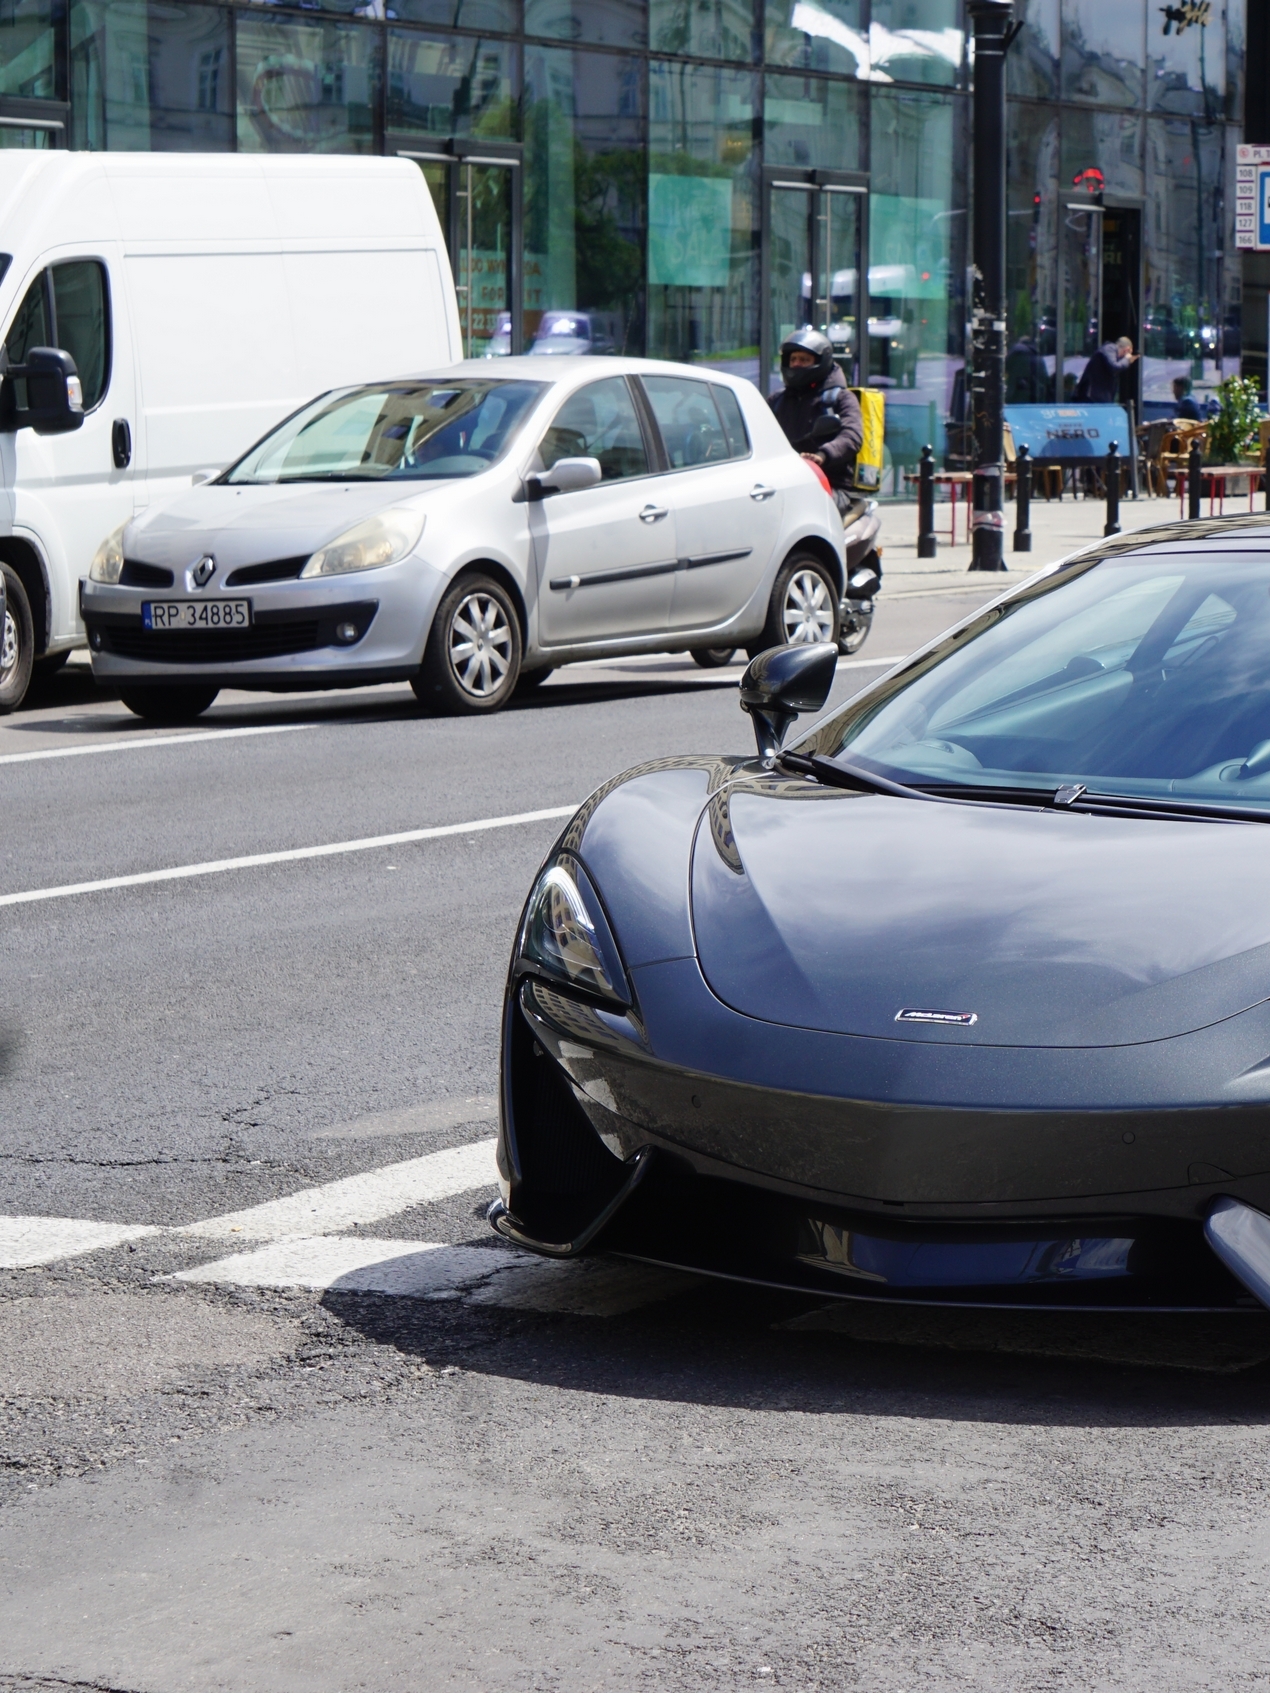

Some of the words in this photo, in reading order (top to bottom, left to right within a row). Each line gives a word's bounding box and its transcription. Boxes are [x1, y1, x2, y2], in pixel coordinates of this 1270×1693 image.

[1253, 150, 1264, 158] Pl.
[1239, 169, 1253, 178] 108
[1239, 185, 1253, 194] 109
[1239, 202, 1253, 211] 118
[1239, 219, 1253, 228] 127
[1238, 236, 1253, 244] 166
[1046, 428, 1099, 439] NERO
[153, 604, 180, 627] RP
[186, 603, 246, 626] 34885
[904, 1011, 963, 1021] McLaren
